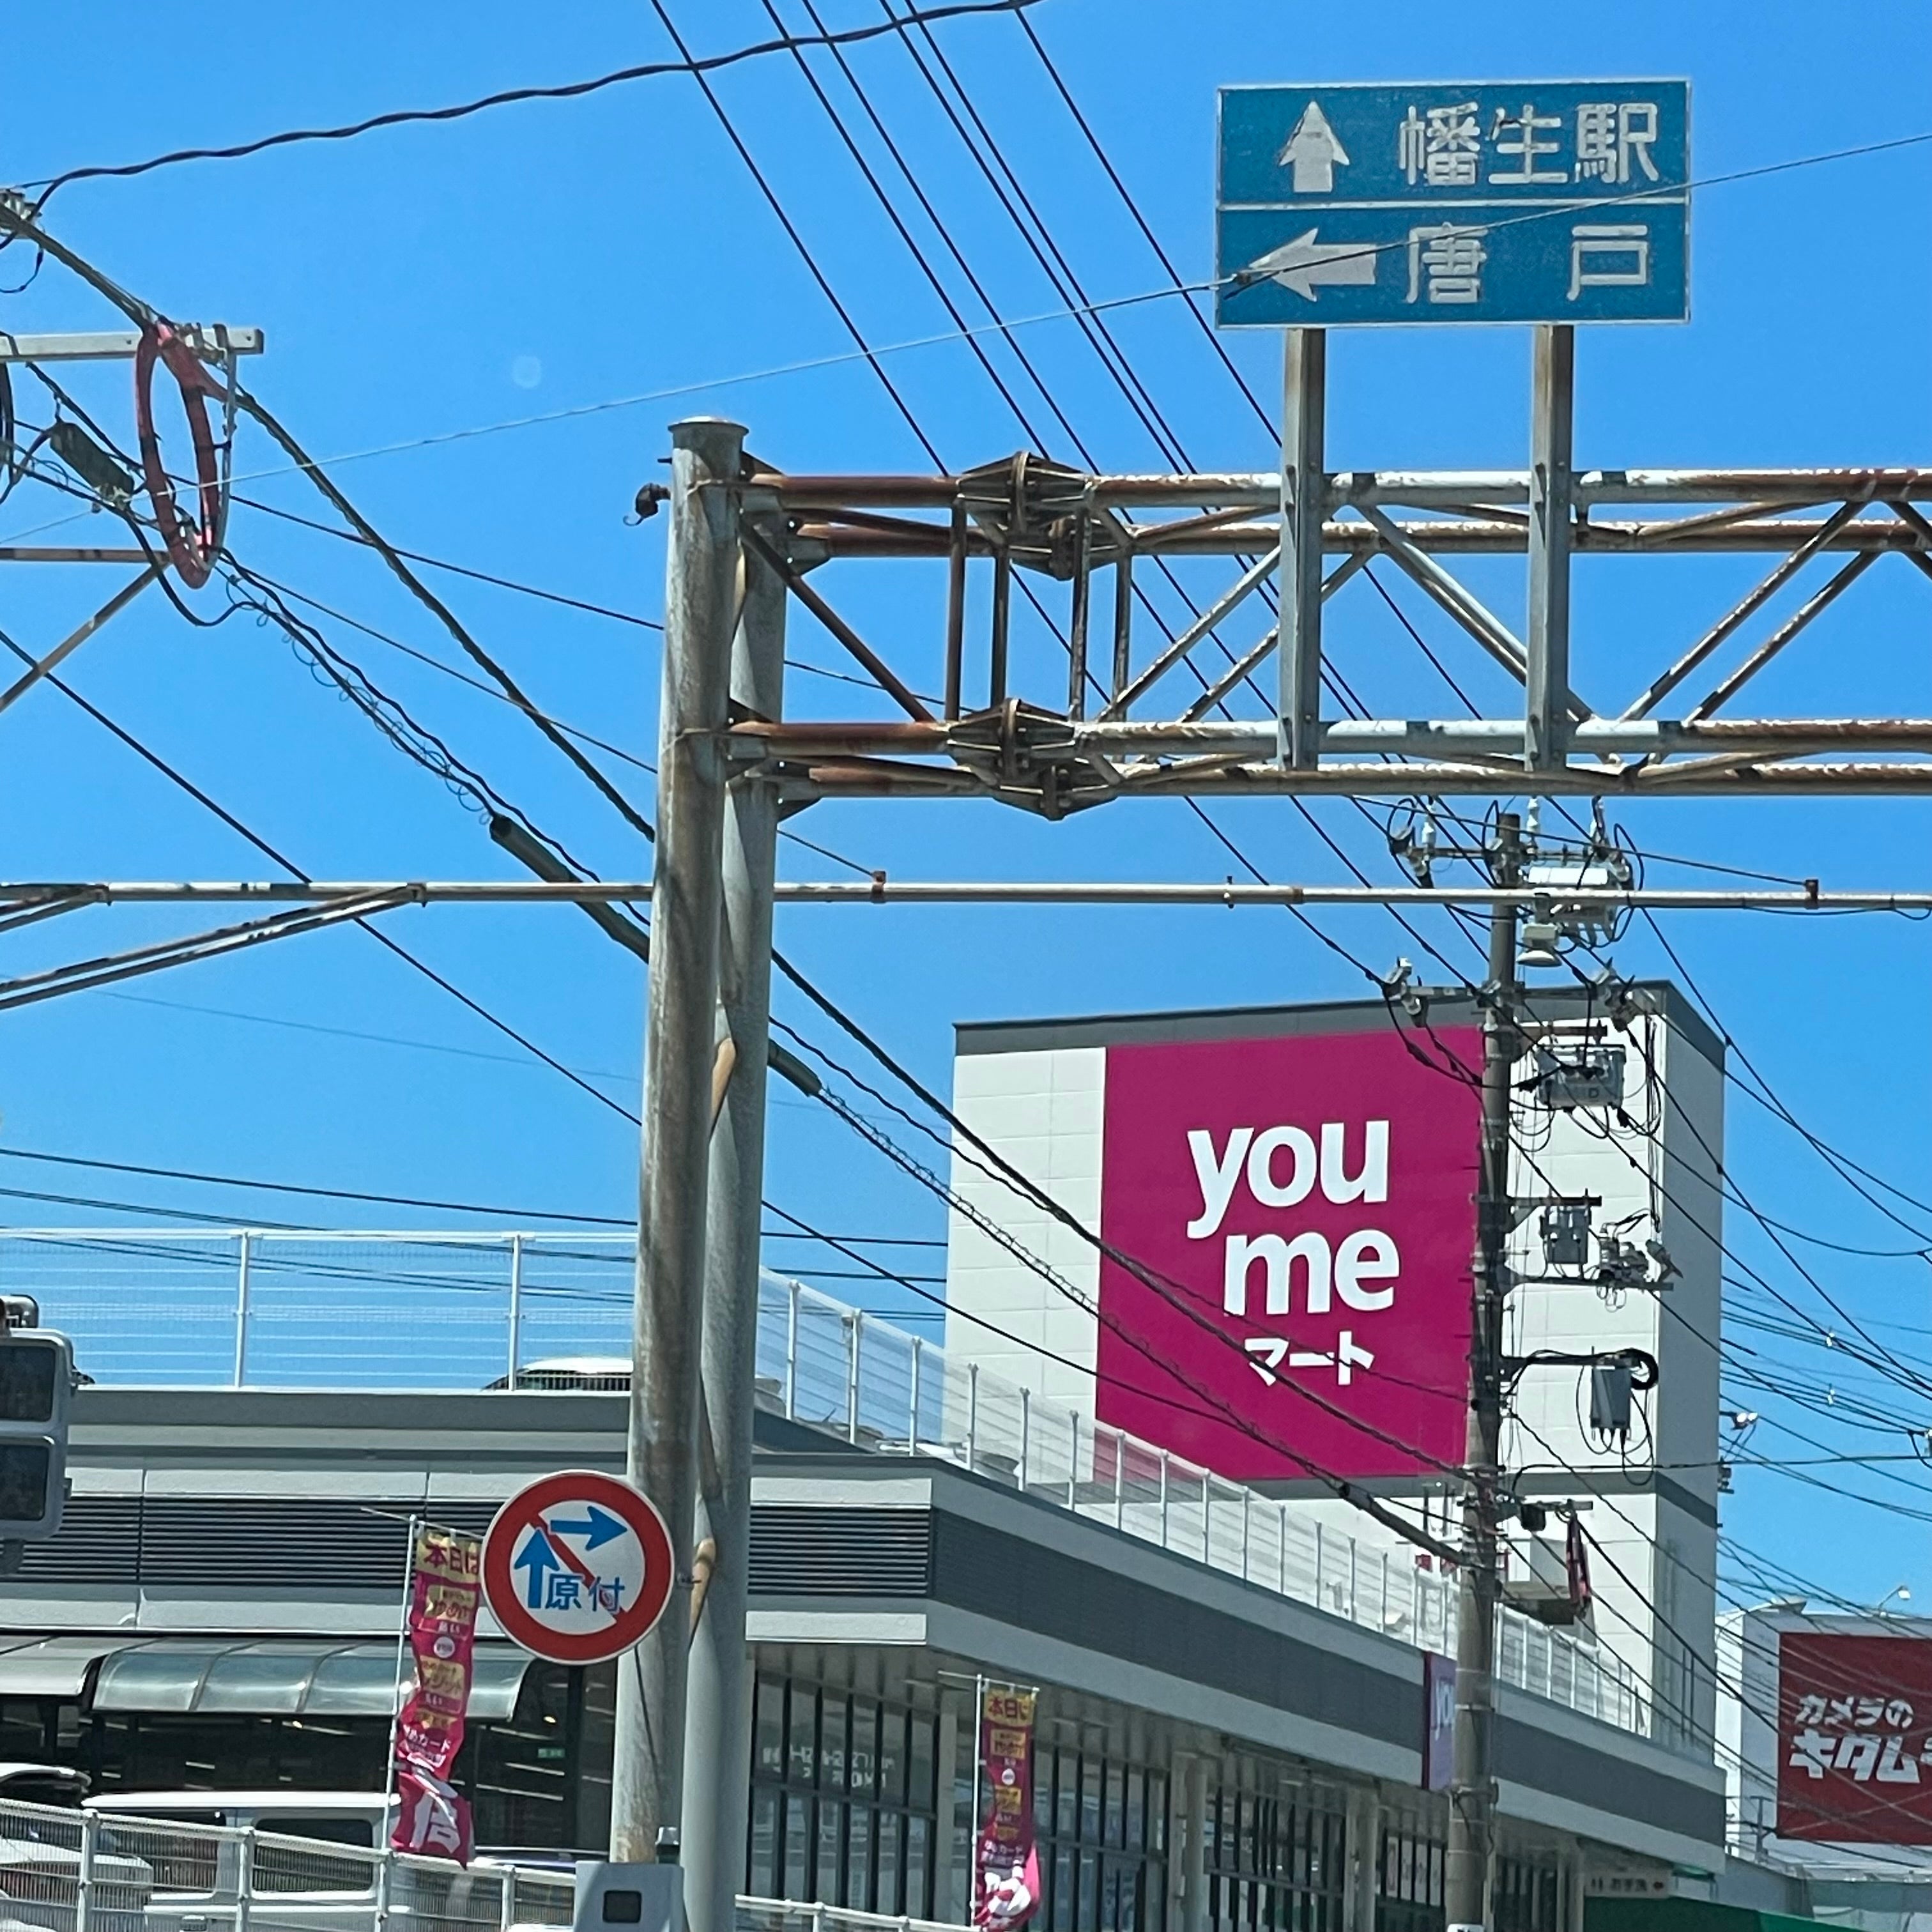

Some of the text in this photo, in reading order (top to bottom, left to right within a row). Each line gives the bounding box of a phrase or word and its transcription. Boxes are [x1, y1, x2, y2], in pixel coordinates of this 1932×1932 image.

[1399, 102, 1659, 185] 幡生駅
[1406, 222, 1648, 303] 唐戸
[1186, 1120, 1390, 1239] you
[1223, 1229, 1400, 1316] me
[1245, 1331, 1375, 1386] マート
[545, 1574, 625, 1611] 原付
[1794, 1694, 1914, 1729] カメラの
[1790, 1728, 1932, 1783] キタム
